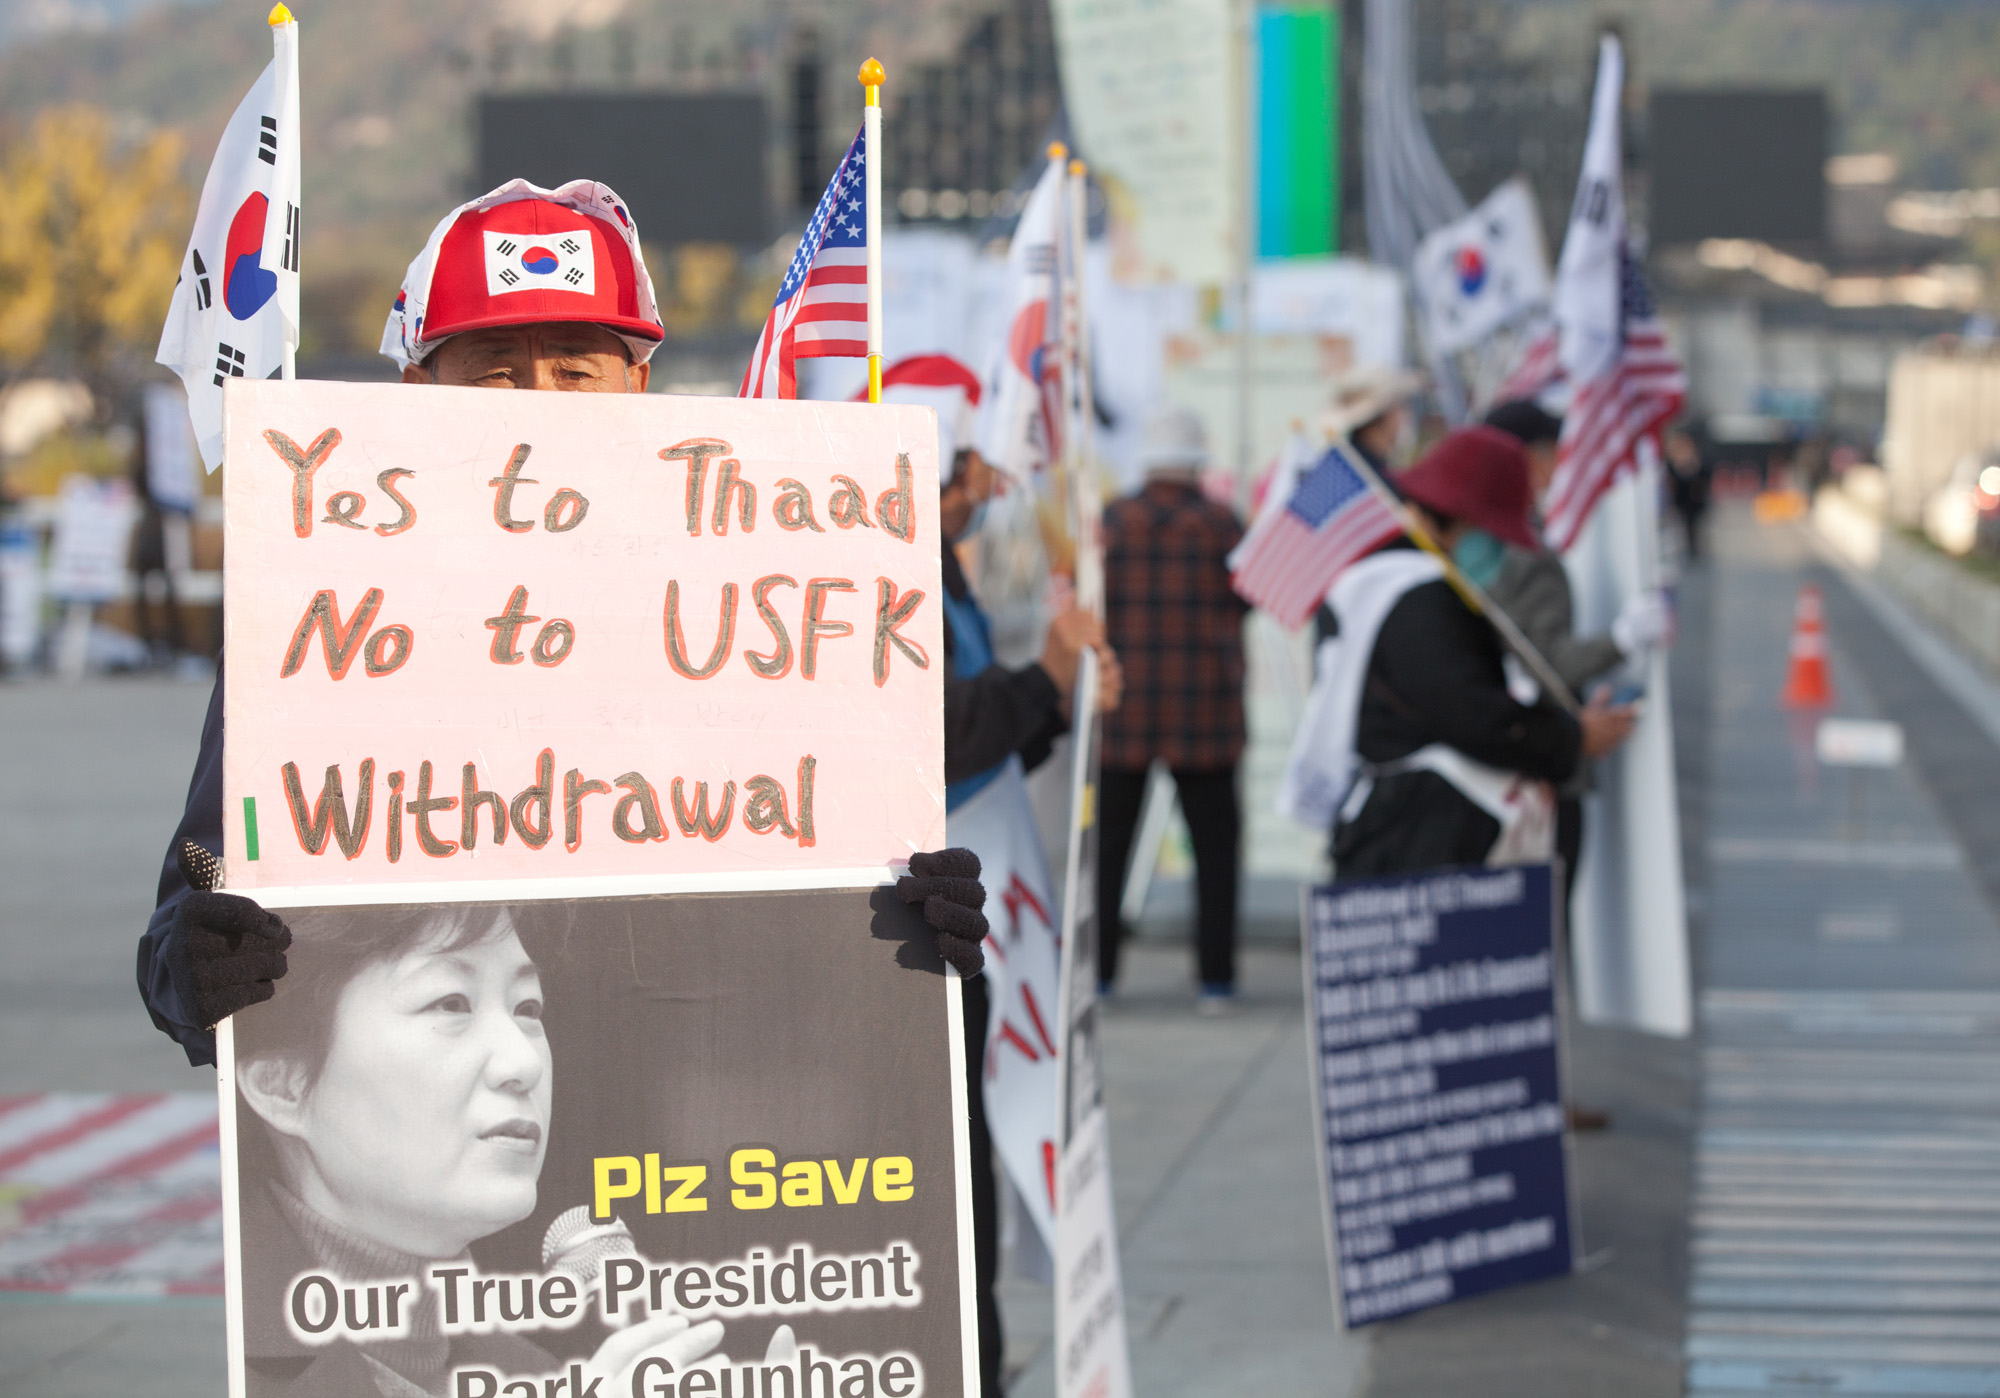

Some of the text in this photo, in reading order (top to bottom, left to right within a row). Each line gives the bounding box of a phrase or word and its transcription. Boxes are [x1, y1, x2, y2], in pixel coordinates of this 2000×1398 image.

[263, 428, 916, 544] Yes to Thaad
[280, 573, 930, 688] No to USFK
[281, 747, 817, 864] Withdrawal
[593, 1148, 915, 1219] Plz Save
[291, 1246, 914, 1335] Our True President
[631, 1349, 916, 1398] Geunhae
